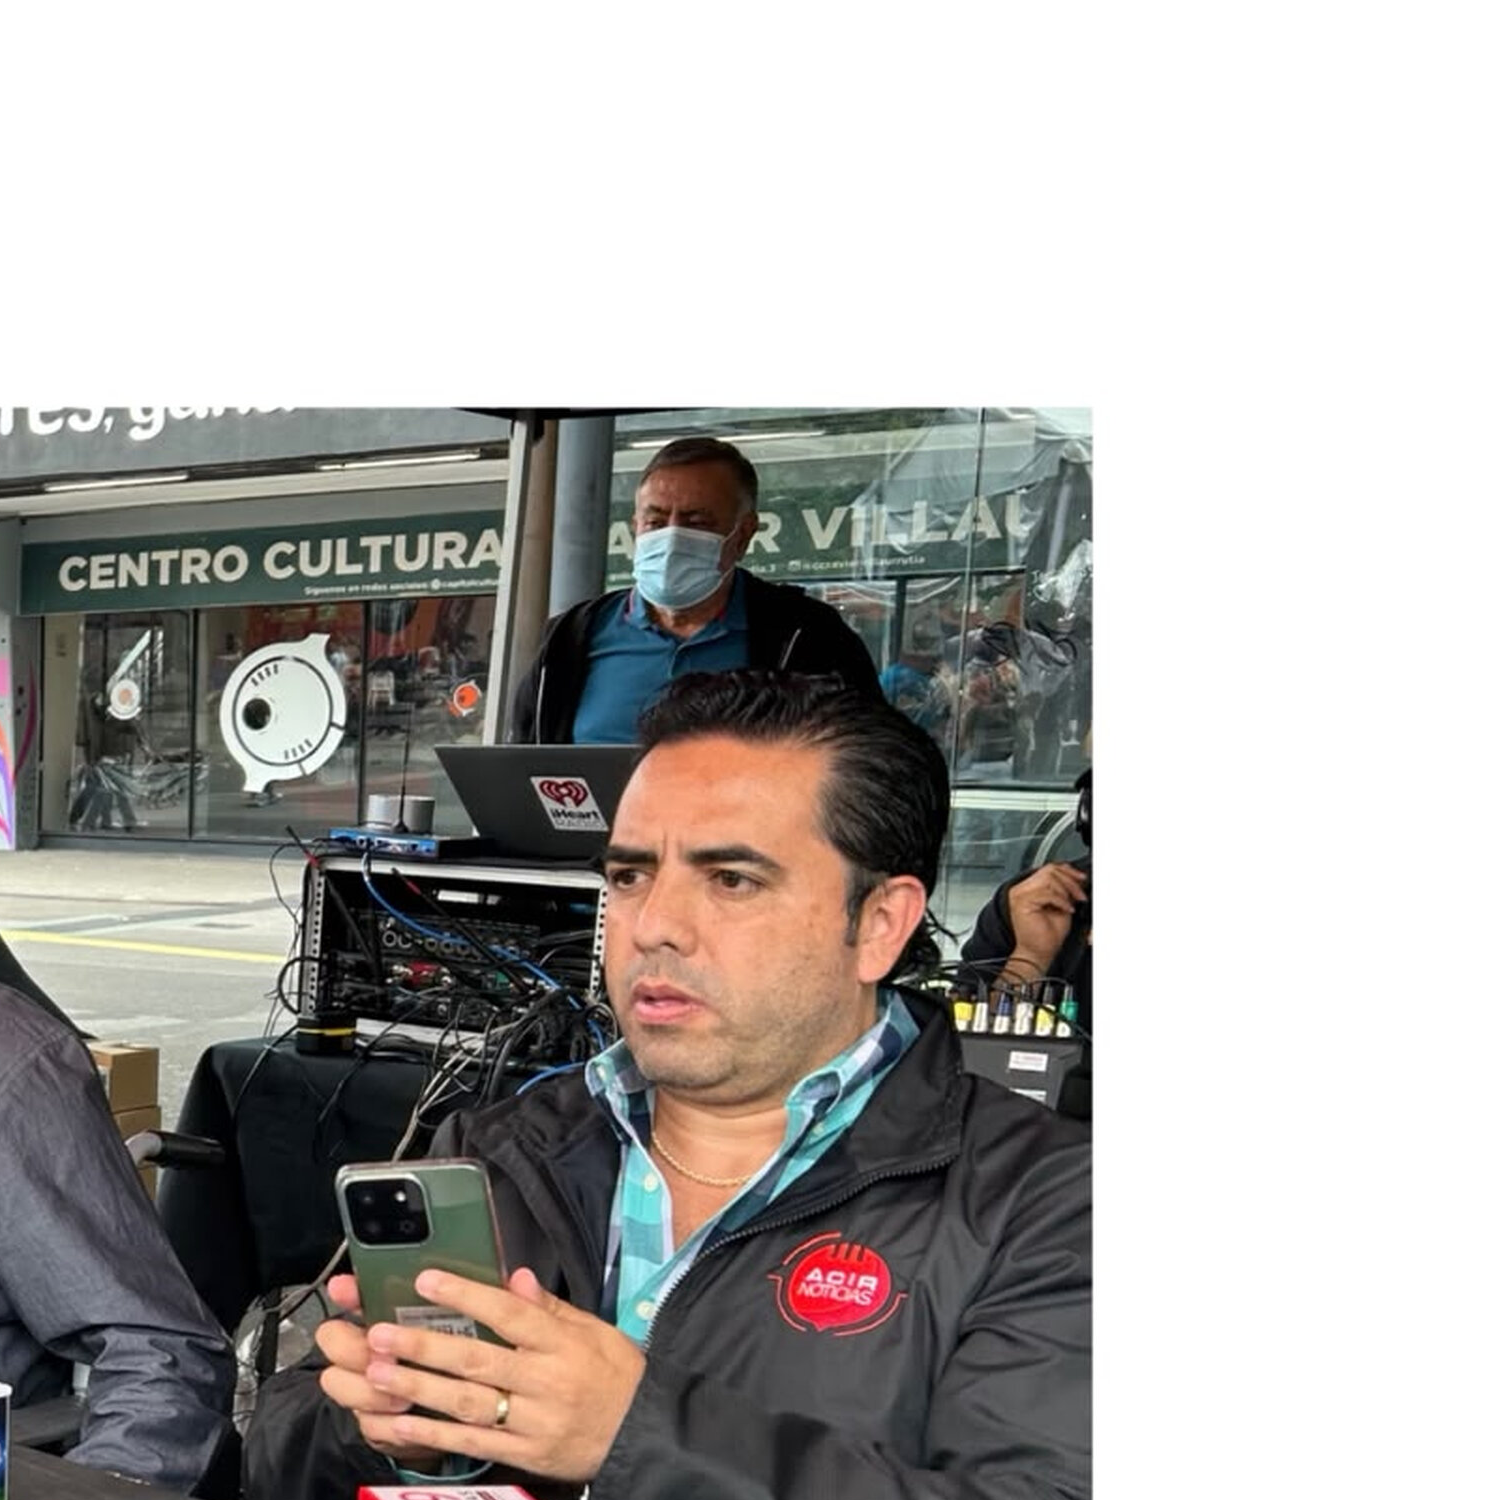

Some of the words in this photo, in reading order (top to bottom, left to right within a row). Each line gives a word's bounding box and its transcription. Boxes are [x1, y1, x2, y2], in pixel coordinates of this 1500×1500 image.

[58, 544, 249, 592] CENTRO
[263, 527, 503, 580] CULTURA
[805, 1267, 879, 1291] ACIR
[797, 1282, 874, 1306] NOTICIAS
